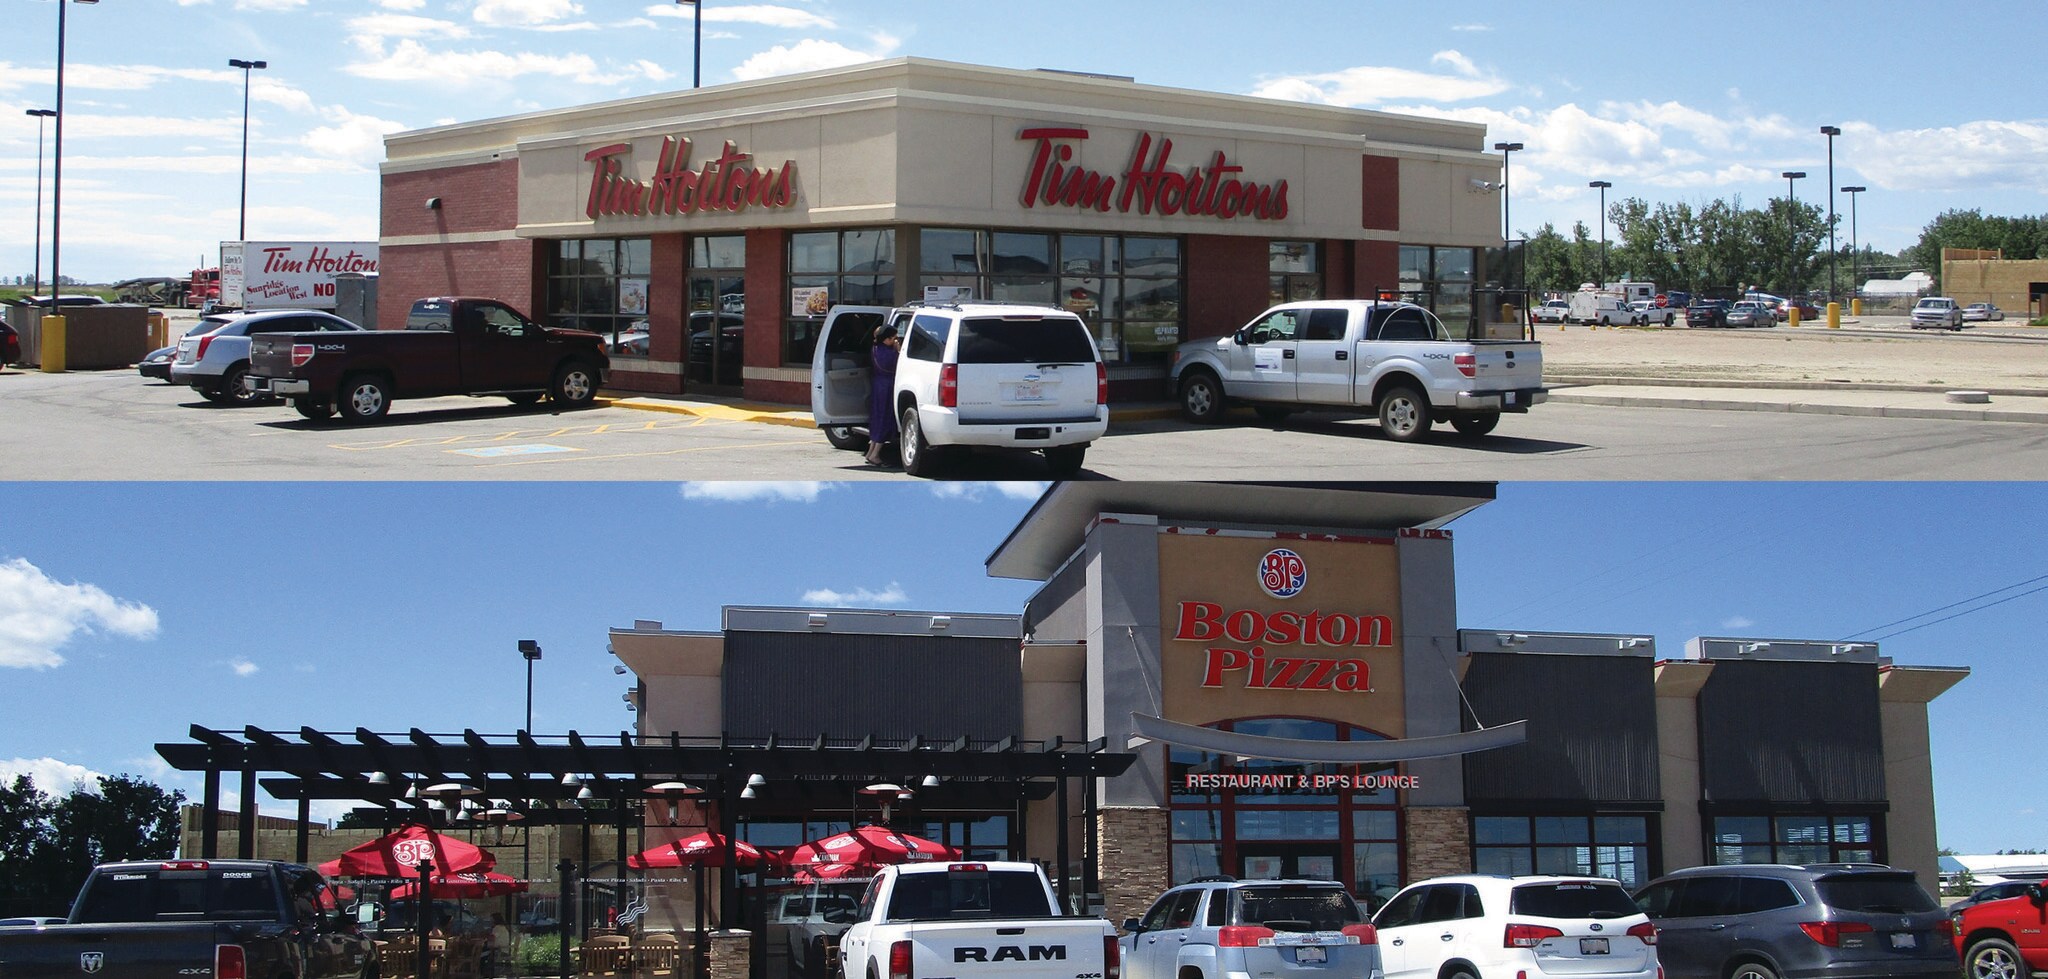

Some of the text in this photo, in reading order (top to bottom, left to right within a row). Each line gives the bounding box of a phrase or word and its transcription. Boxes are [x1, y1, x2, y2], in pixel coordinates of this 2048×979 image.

[584, 135, 797, 219] Tim Hortons
[1016, 128, 1289, 220] Tim Hortons
[263, 247, 303, 273] Tim
[247, 280, 284, 294] Sunridge
[264, 285, 300, 298] Location
[289, 291, 307, 300] West
[1264, 553, 1304, 592] BP
[1173, 601, 1393, 648] Boston
[1200, 646, 1371, 693] Pizza
[1186, 774, 1419, 789] RESTAURANT & BP'S LOUNGE
[954, 945, 1066, 962] RAM
